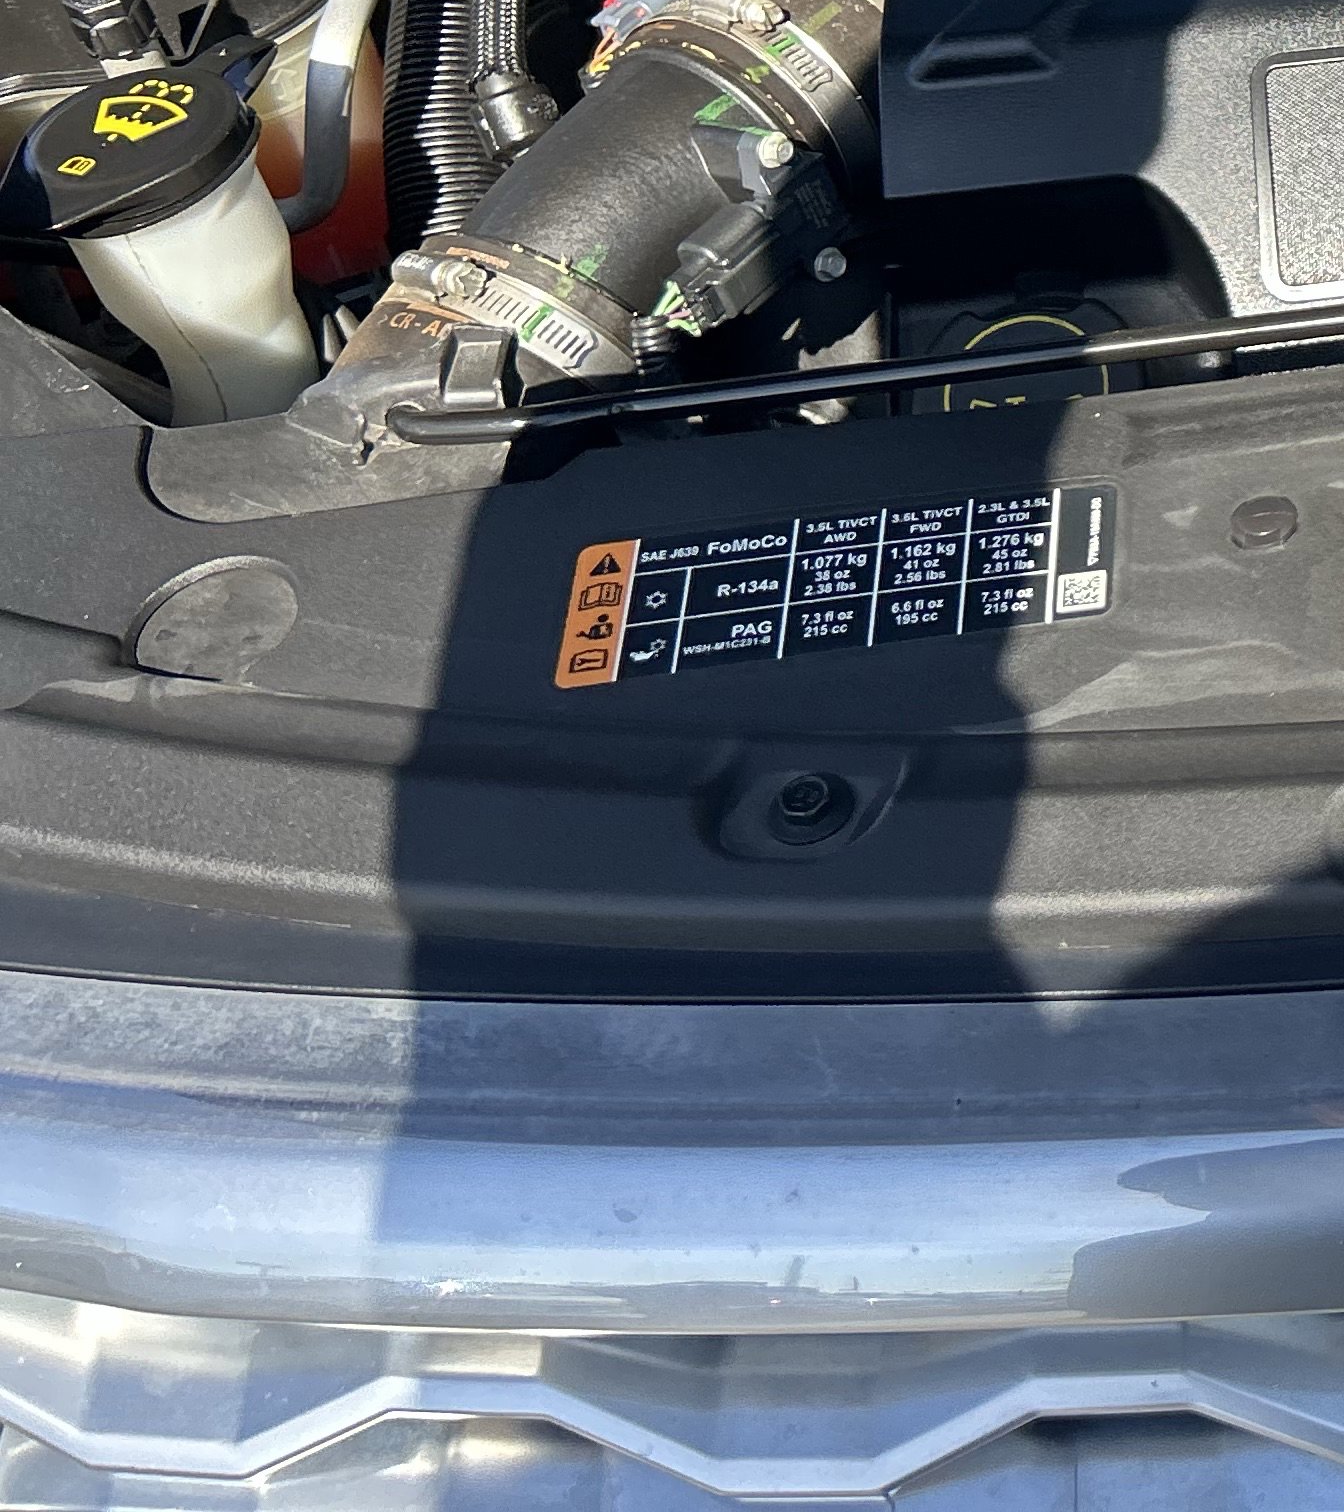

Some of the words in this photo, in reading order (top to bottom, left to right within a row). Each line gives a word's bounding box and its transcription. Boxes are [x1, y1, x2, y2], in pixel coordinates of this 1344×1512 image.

[978, 503, 1006, 514] 2.3L
[1009, 501, 1019, 510] &
[1022, 497, 1050, 508] 3.5L
[996, 512, 1030, 524] GTDI
[909, 521, 942, 534] FWD
[707, 534, 788, 555] FoMoCo
[823, 532, 857, 544] AWD
[978, 533, 1020, 549] 1.276
[1024, 532, 1044, 547] kg
[640, 550, 667, 563] SAE
[891, 543, 932, 560] 1.162
[936, 542, 956, 556] kg
[992, 549, 1008, 560] 45
[1011, 548, 1028, 558] oz
[801, 554, 843, 570] 1.077
[847, 553, 868, 567] kg
[903, 559, 919, 570] 41
[923, 559, 940, 568] oz
[982, 562, 1010, 574] 2.81
[1014, 559, 1035, 570] lbs
[815, 570, 831, 582] 38
[833, 569, 850, 579] oz
[893, 571, 922, 585] 2.56
[925, 570, 946, 581] lbs
[717, 579, 779, 597] R-134a
[804, 583, 833, 596] 2.38
[836, 581, 856, 592] lbs
[981, 591, 1001, 603] 7.3
[1004, 588, 1013, 599] fl
[1016, 587, 1034, 598] oz
[891, 602, 912, 614] 6.6
[915, 599, 924, 611] fl
[927, 599, 944, 609] oz
[983, 602, 1008, 615] 215
[1011, 601, 1028, 611] cc
[802, 613, 821, 626] 7.3
[824, 611, 834, 622] fl
[837, 610, 854, 620] oz
[895, 613, 919, 625] 195
[921, 612, 938, 623] cc
[731, 620, 773, 638] PAG
[803, 625, 828, 638] 215
[831, 624, 848, 634] cc
